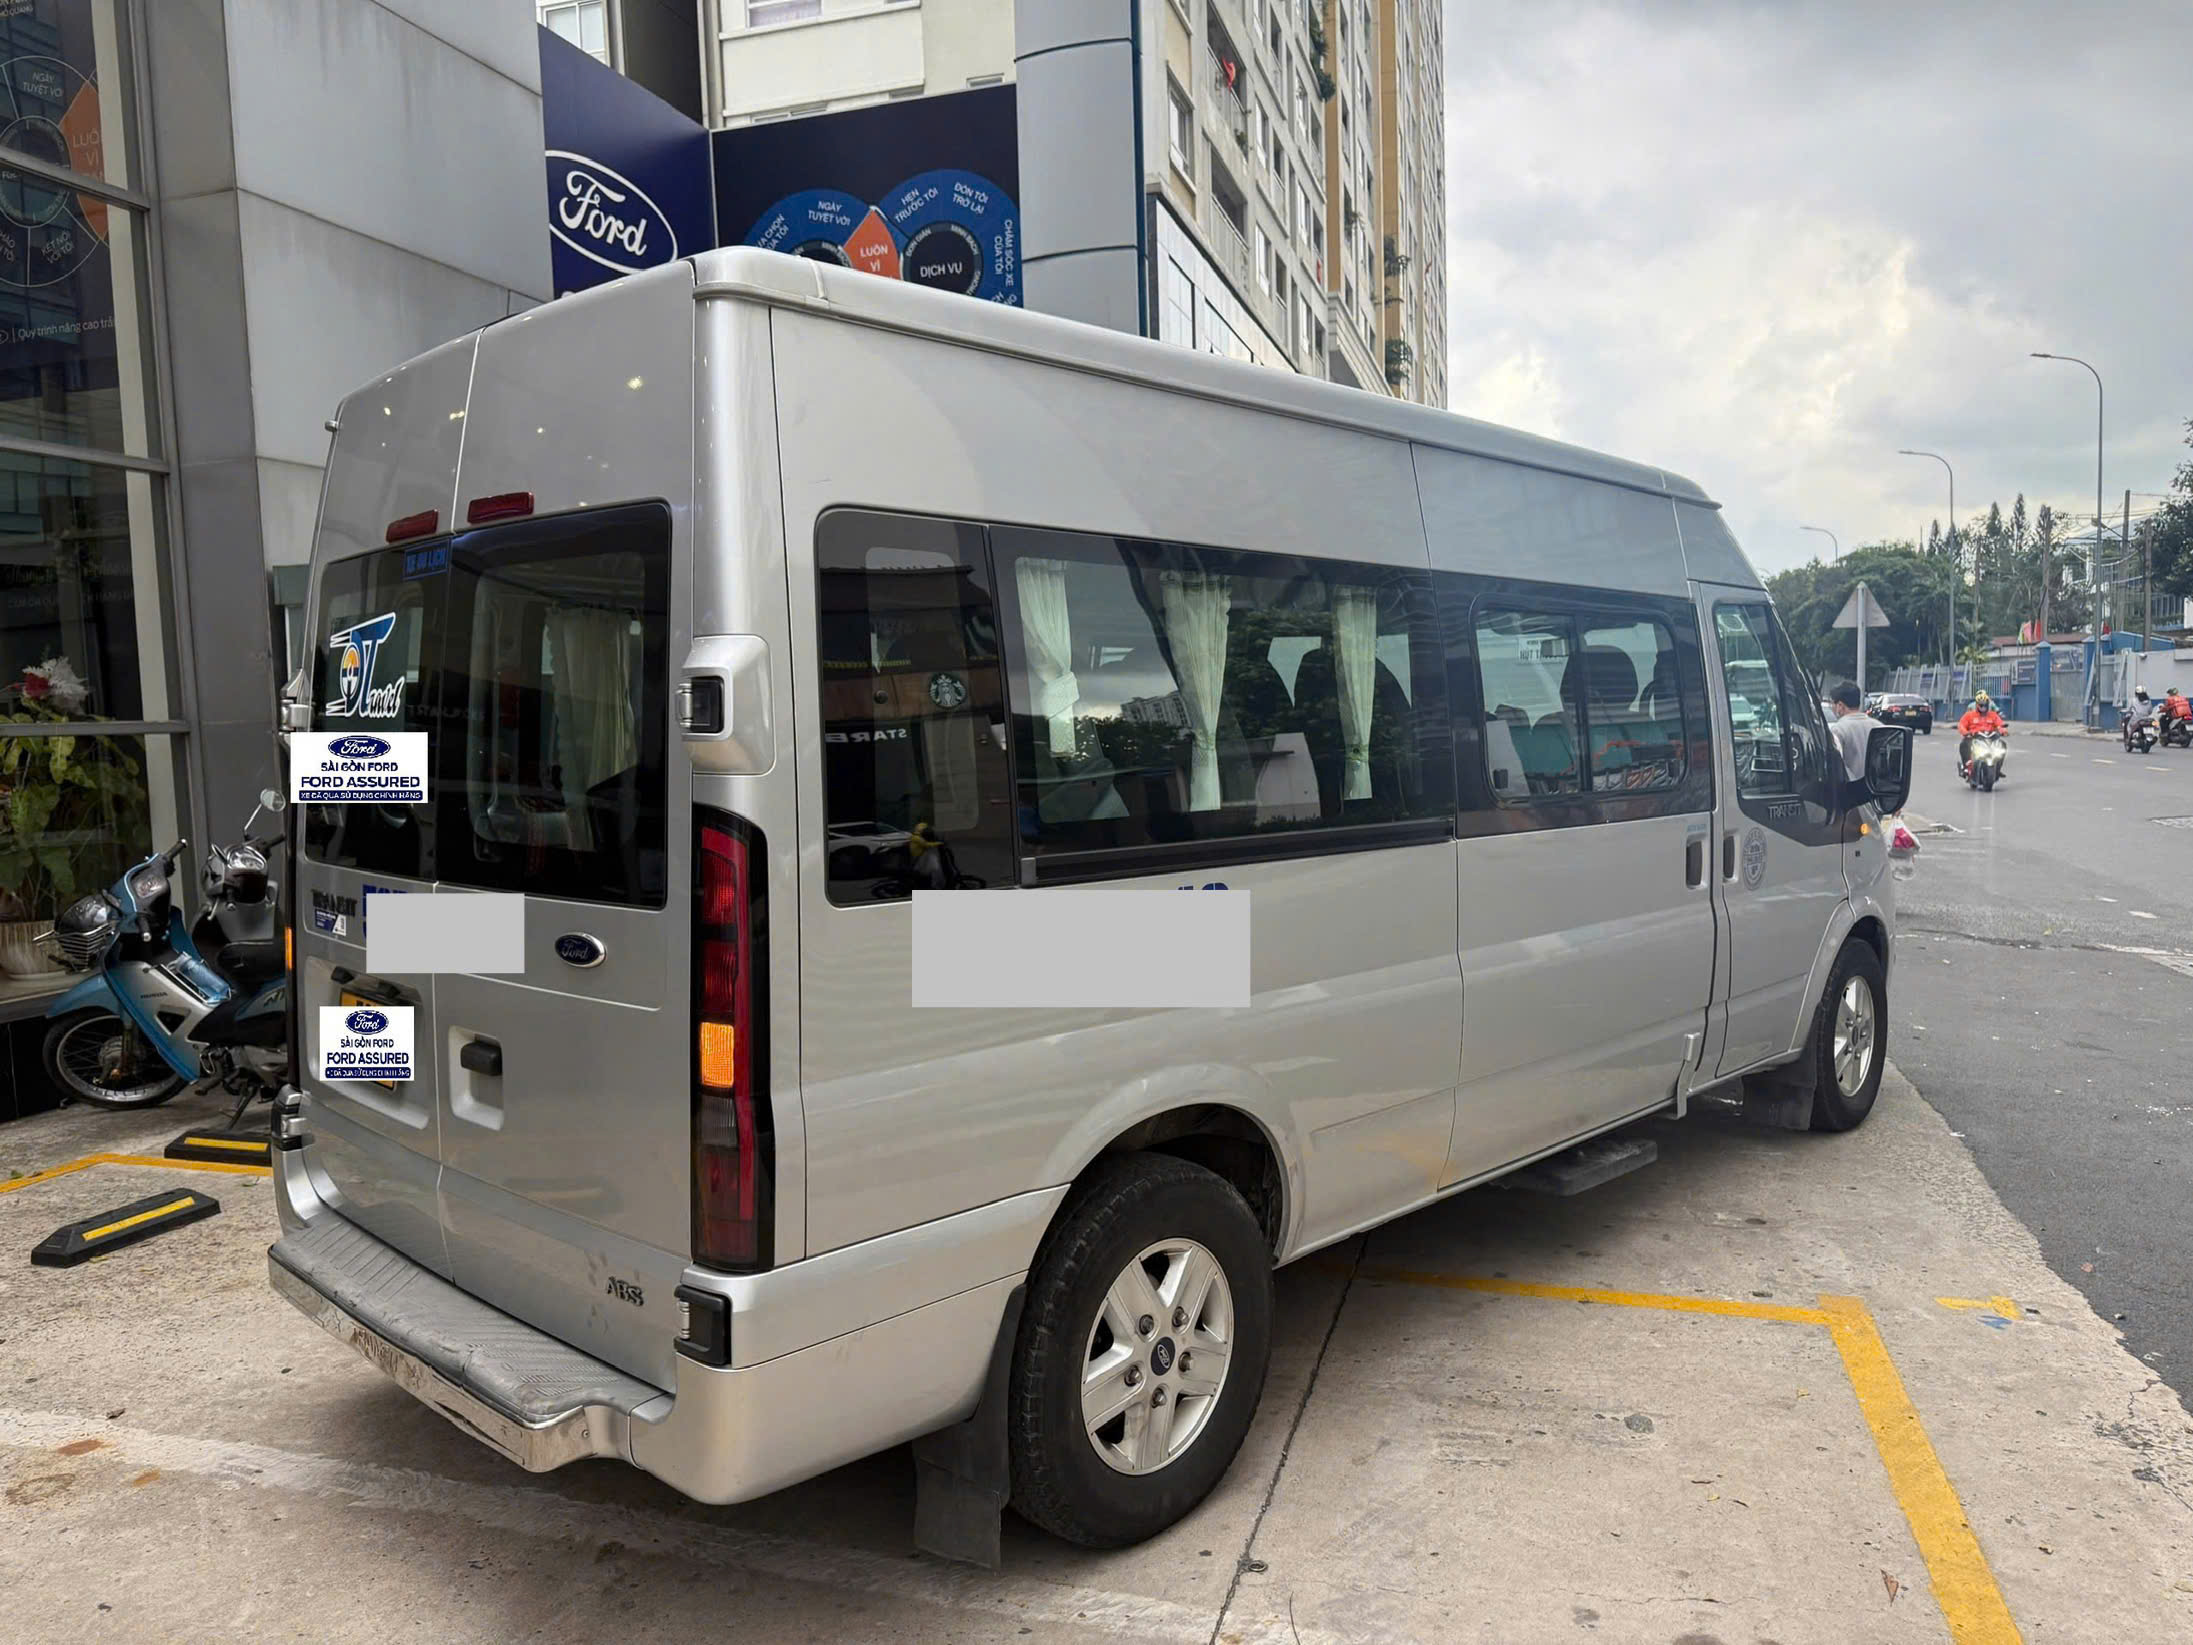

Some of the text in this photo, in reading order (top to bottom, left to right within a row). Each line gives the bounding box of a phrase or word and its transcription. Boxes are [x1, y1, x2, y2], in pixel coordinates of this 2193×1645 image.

[559, 171, 647, 256] Ford
[861, 243, 888, 258] LUÔN
[920, 262, 963, 279] DỊCH VỤ
[1005, 273, 1014, 287] XE
[561, 939, 589, 960] Ford
[607, 1276, 644, 1307] ABS
